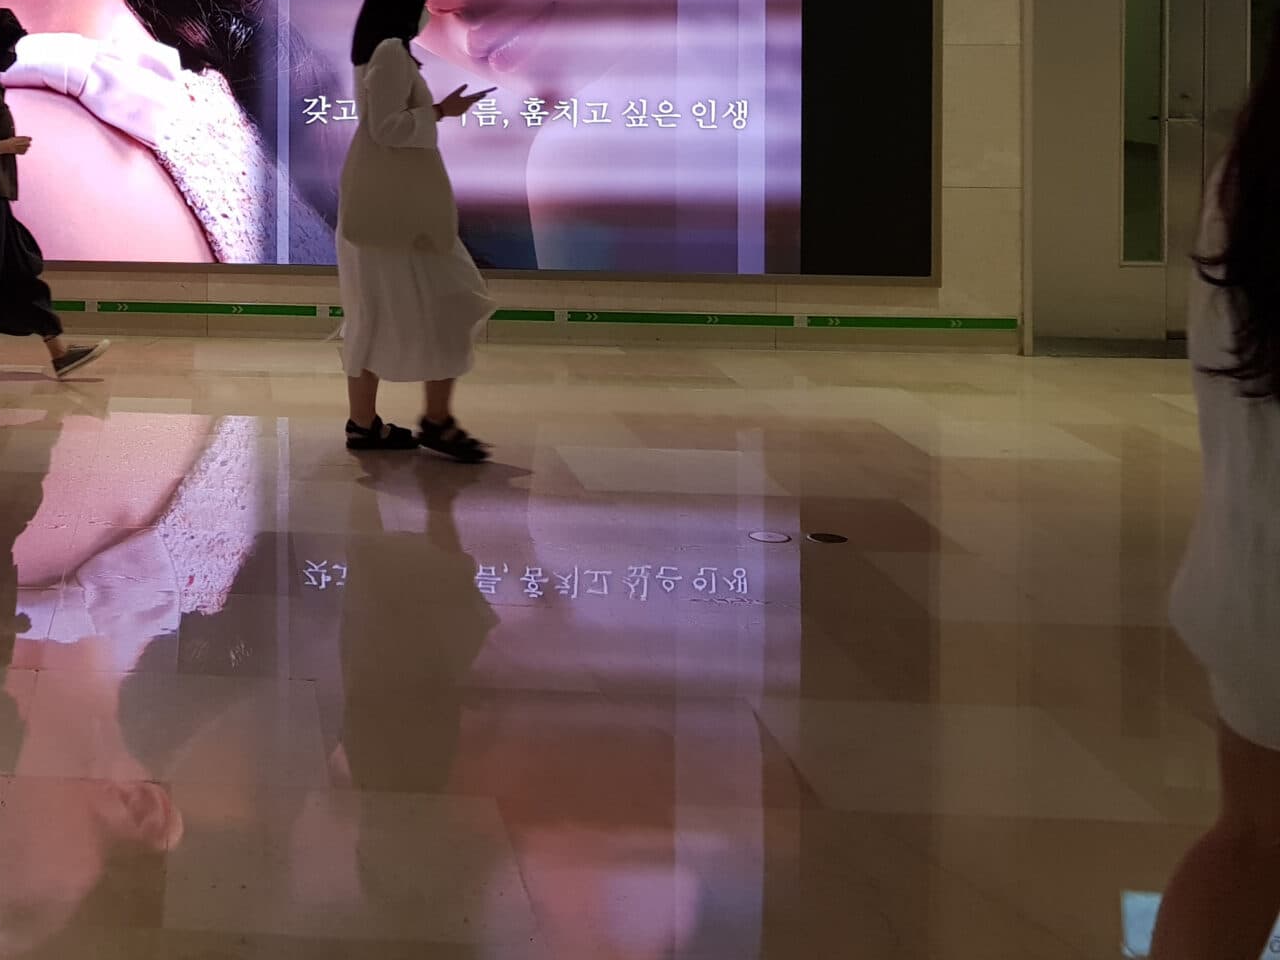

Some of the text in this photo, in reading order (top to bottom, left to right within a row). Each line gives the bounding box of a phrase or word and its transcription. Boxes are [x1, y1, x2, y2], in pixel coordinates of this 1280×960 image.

[302, 96, 358, 124] 갖고
[519, 97, 612, 129] 훔치고
[622, 98, 681, 129] 싶은
[692, 99, 748, 130] 인생
